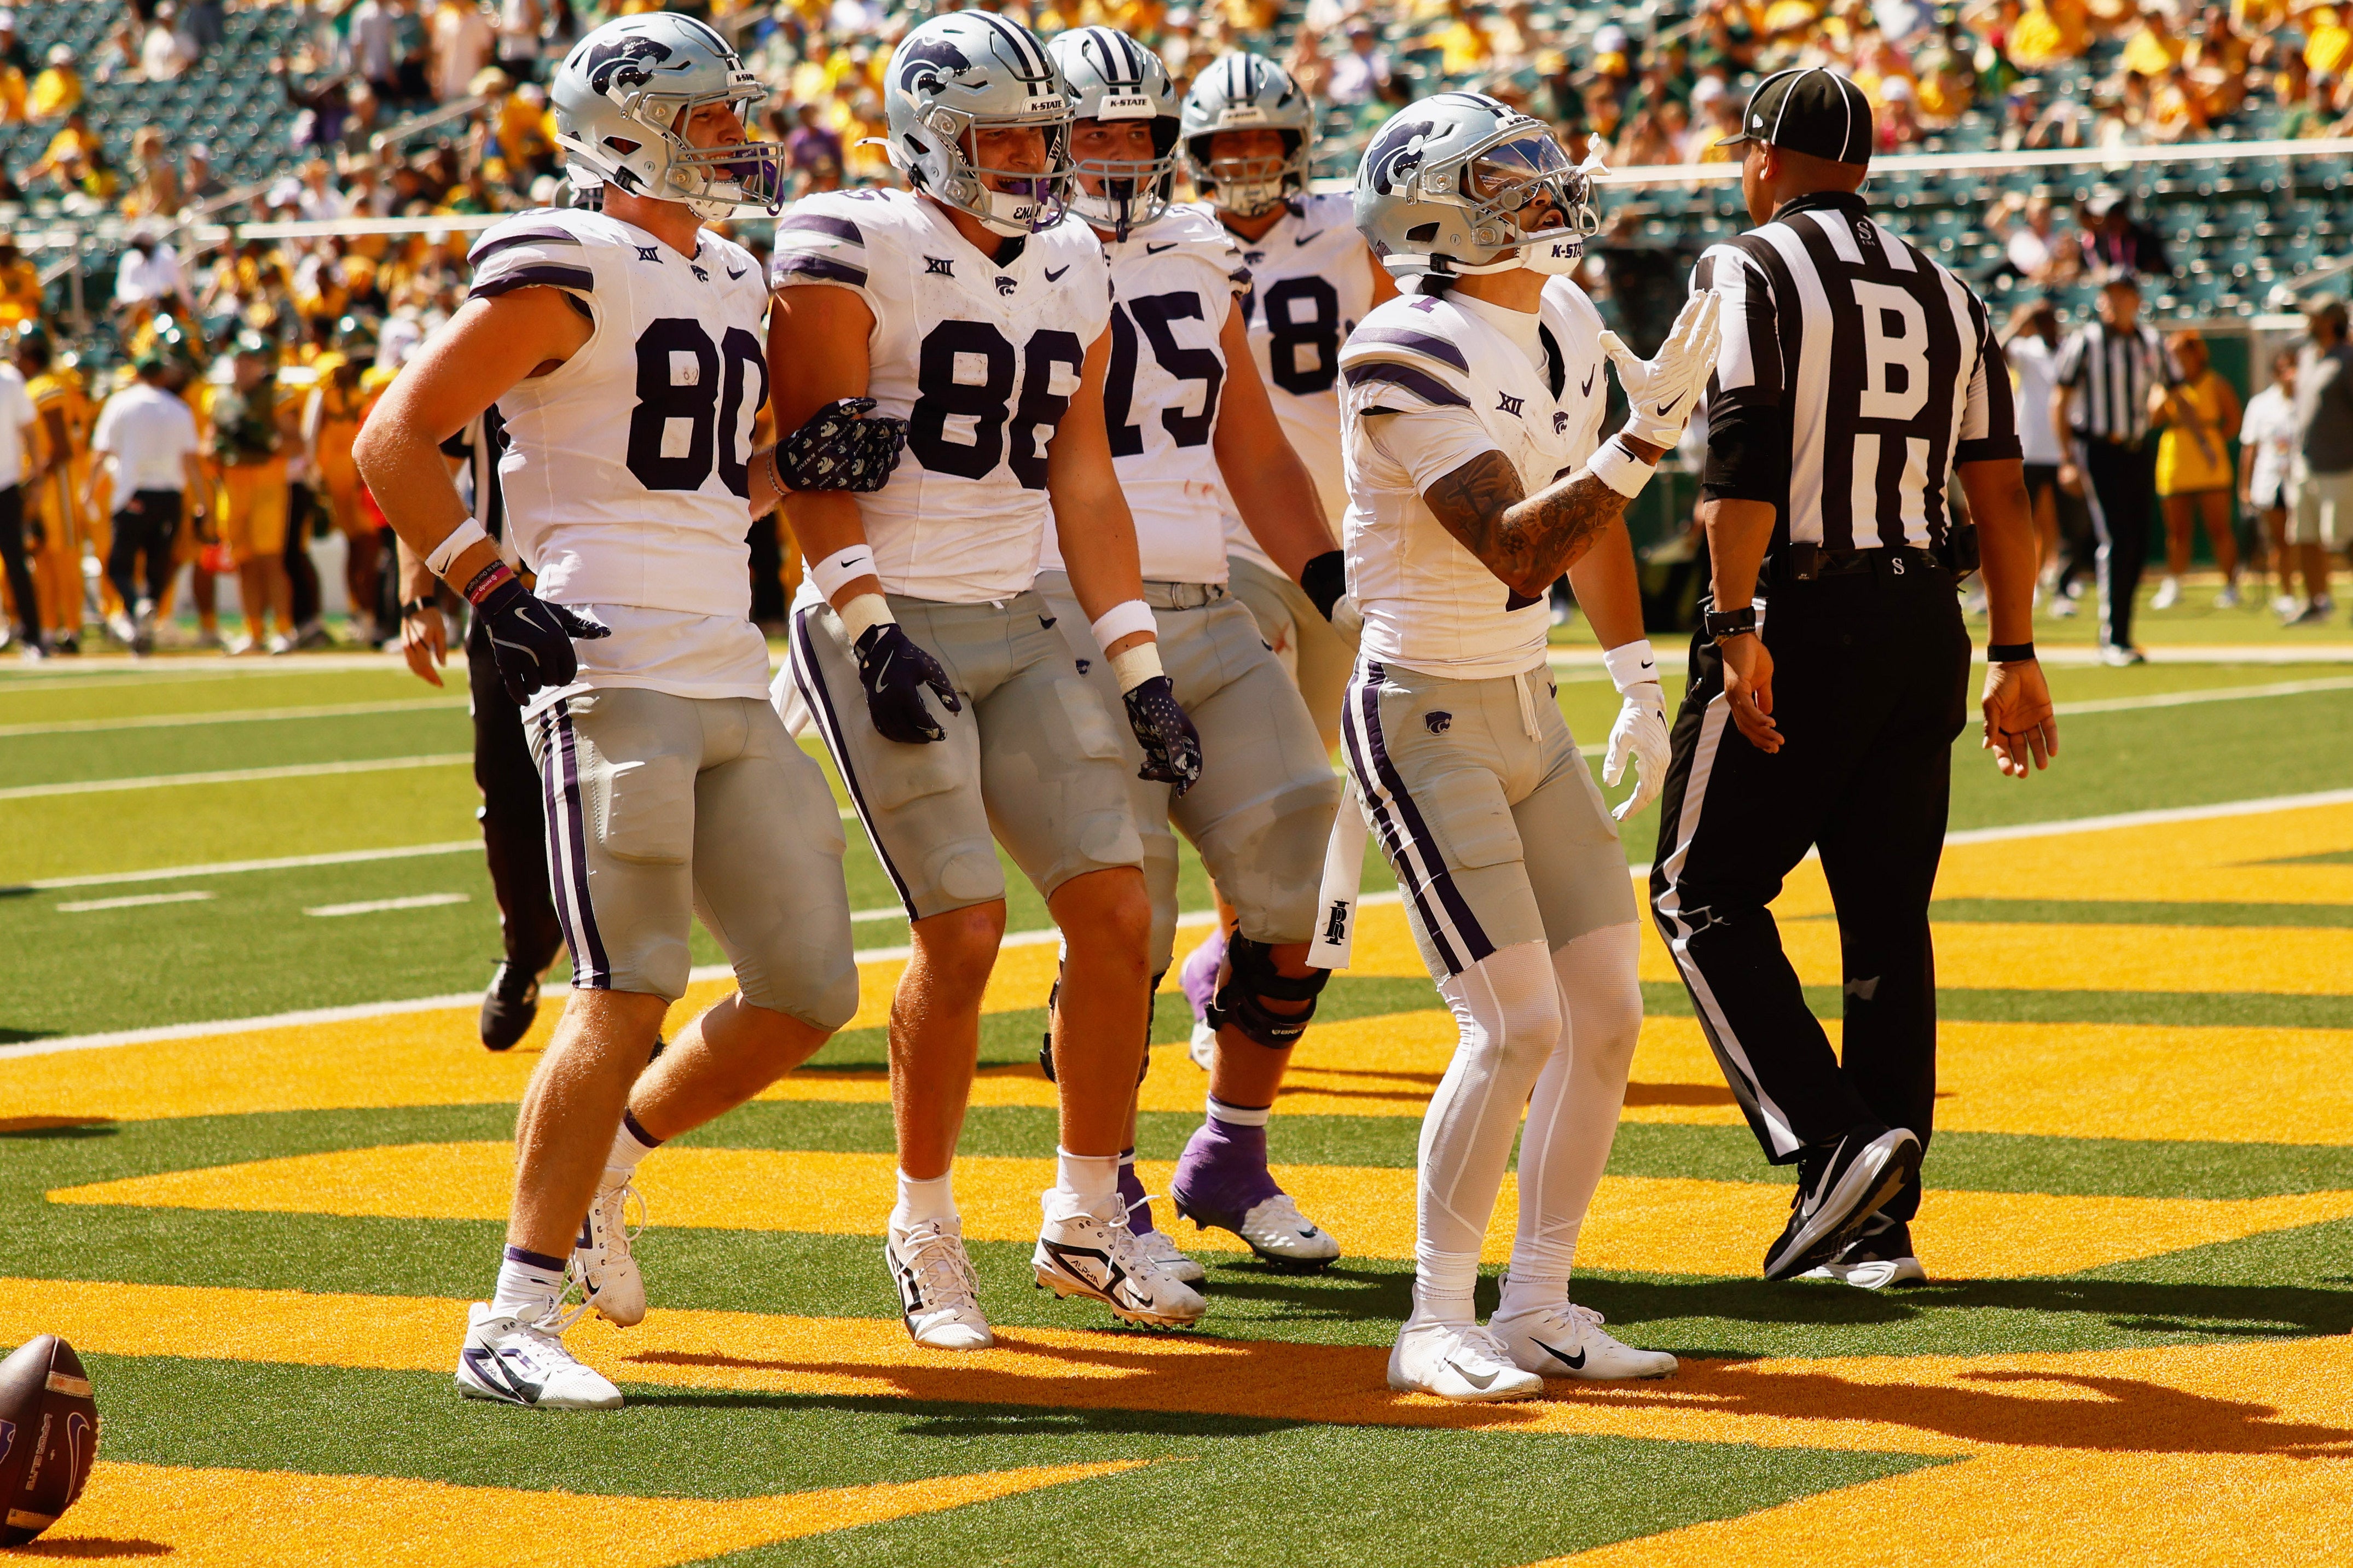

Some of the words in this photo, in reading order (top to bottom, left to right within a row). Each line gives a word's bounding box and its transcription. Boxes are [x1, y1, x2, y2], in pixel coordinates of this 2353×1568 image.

[1031, 100, 1062, 111] K-STATE
[1110, 99, 1147, 107] K-STATE
[1551, 242, 1583, 258] K-STA
[924, 255, 955, 277] XII
[1851, 280, 1929, 420] B
[626, 317, 769, 500] 80
[1496, 390, 1525, 419] XII
[796, 453, 816, 473] K-STATE
[479, 579, 492, 591] nmdp
[1070, 1260, 1099, 1286] ALPHA
[25, 1454, 42, 1491] ELITE
